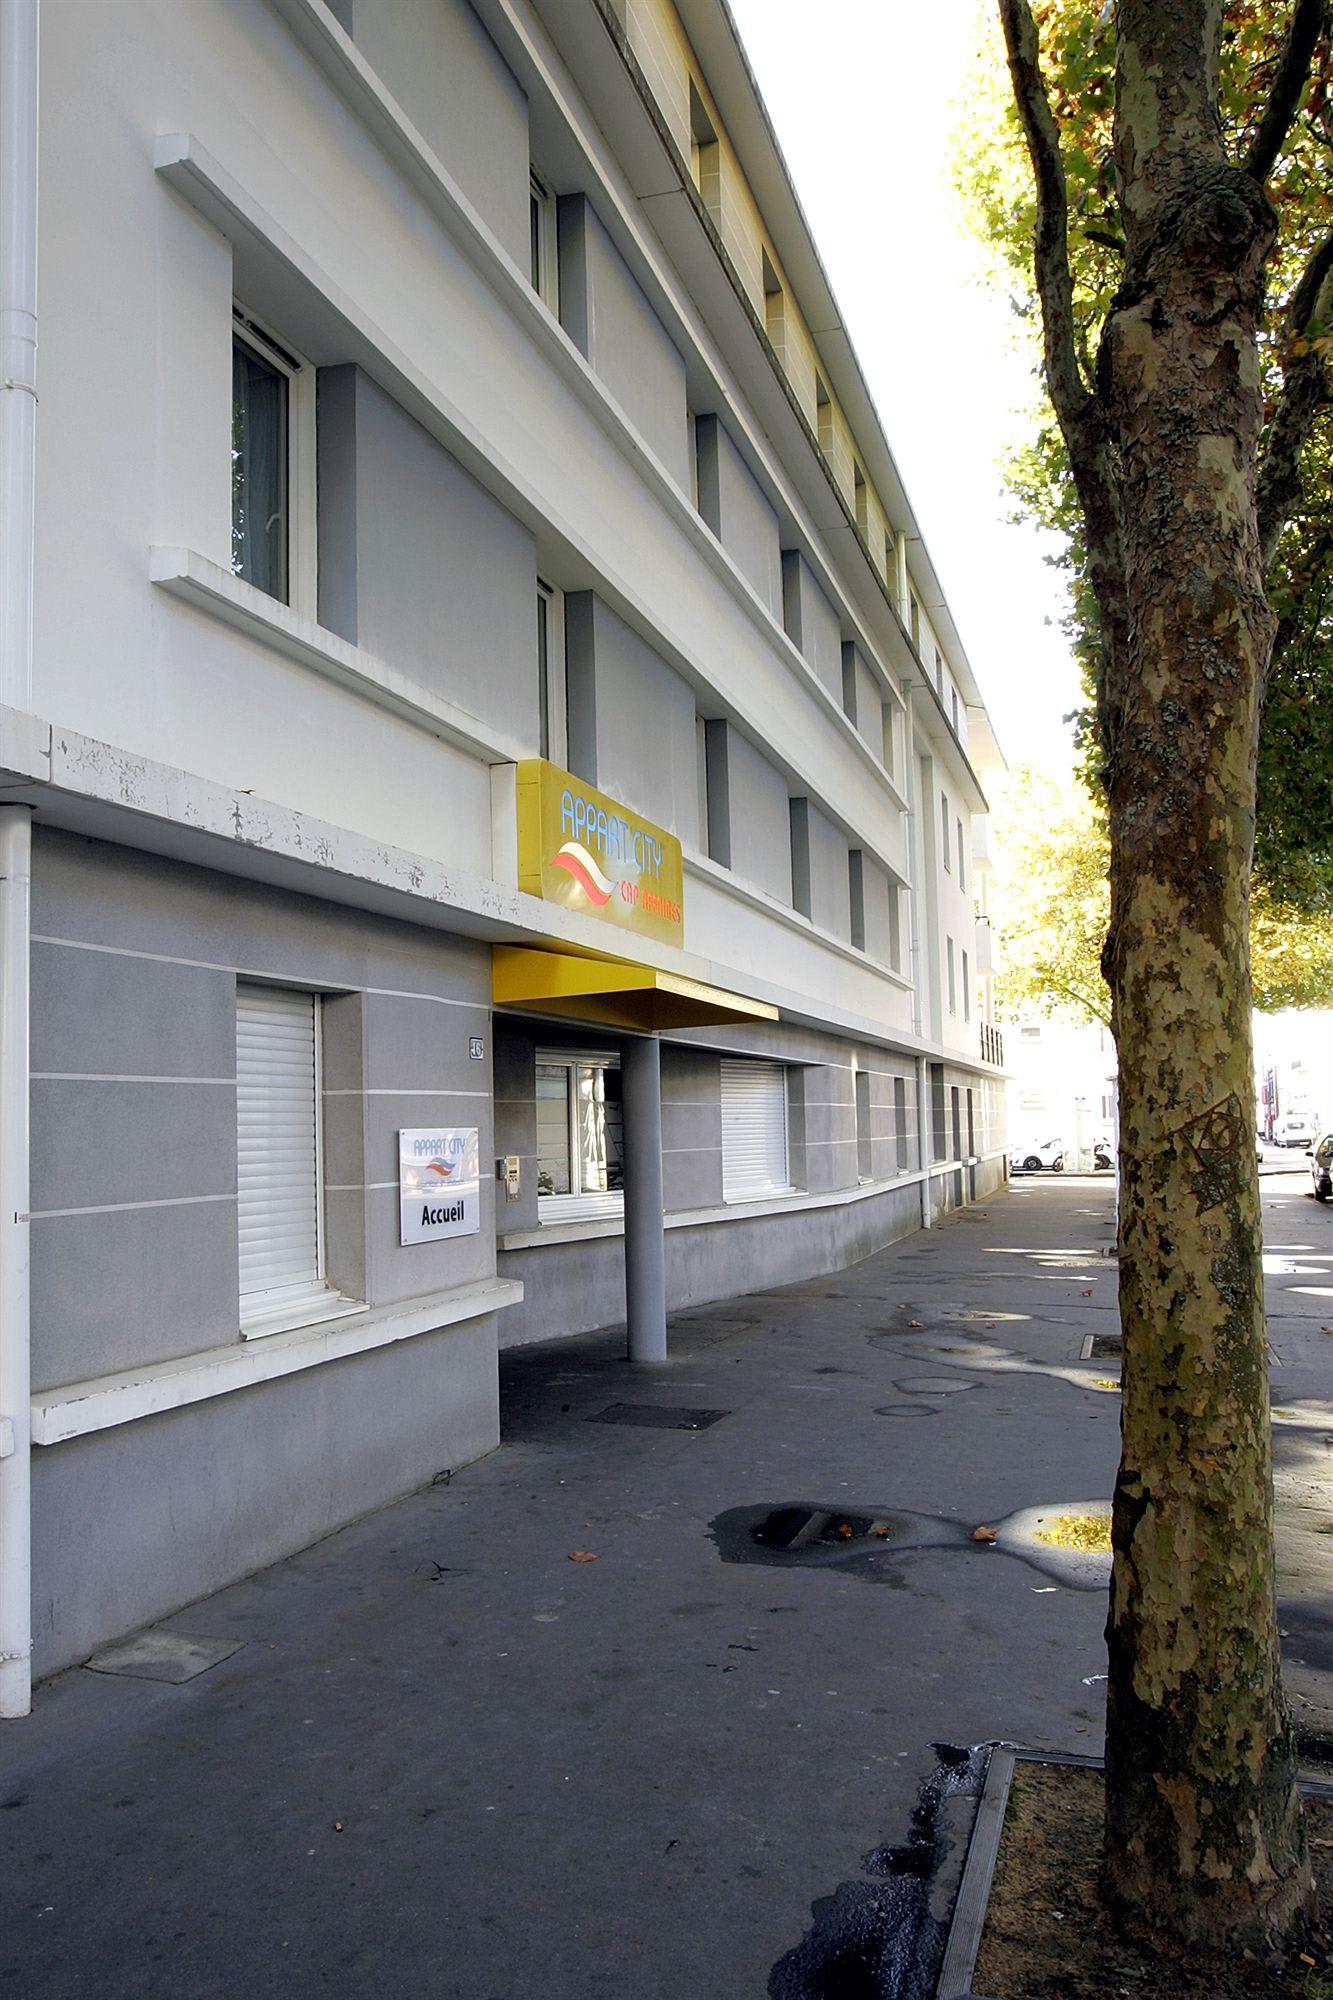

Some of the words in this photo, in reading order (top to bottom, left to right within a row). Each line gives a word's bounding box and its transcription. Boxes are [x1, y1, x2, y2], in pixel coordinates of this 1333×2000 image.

[561, 789, 628, 863] APPART
[632, 831, 663, 880] CITY
[621, 880, 638, 905] CAP
[414, 1138, 446, 1156] APPART
[449, 1137, 465, 1154] CITY
[421, 1201, 464, 1226] Accueil
